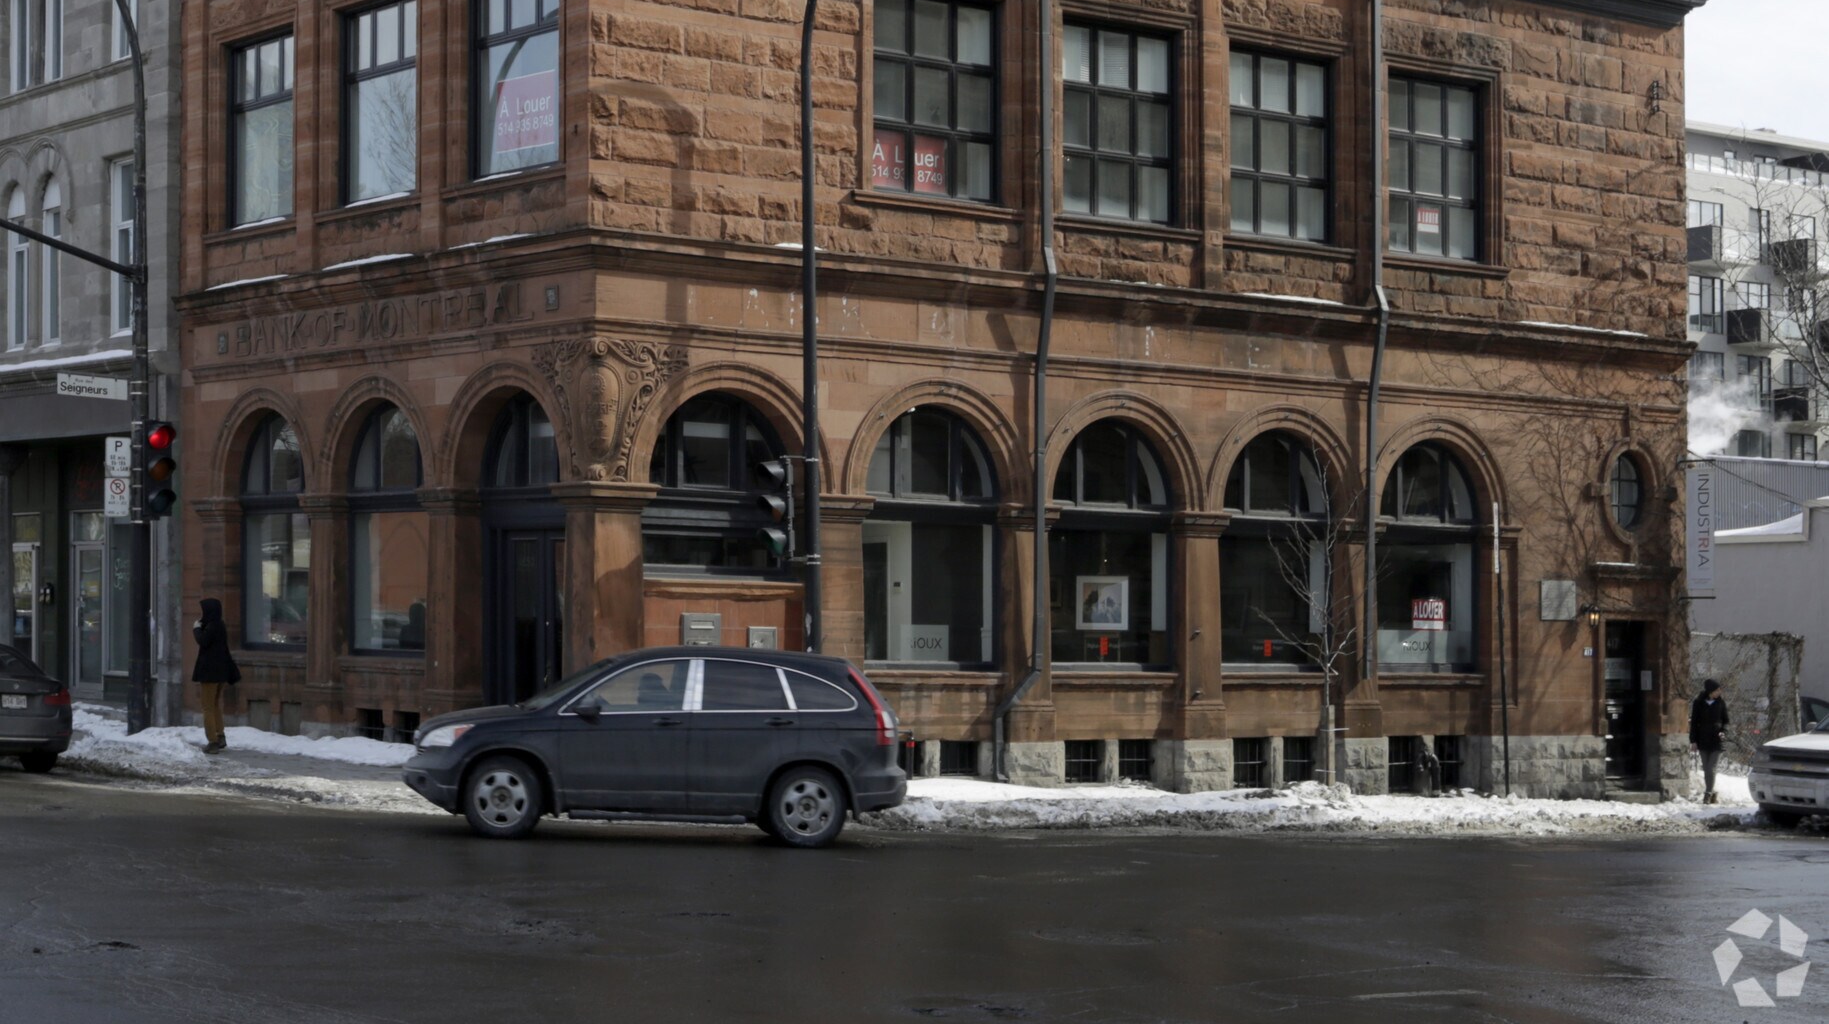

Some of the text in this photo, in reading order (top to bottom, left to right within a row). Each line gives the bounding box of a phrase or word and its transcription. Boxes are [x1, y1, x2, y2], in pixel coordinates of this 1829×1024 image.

[499, 95, 551, 118] À Louer
[497, 121, 513, 136] 514
[532, 113, 554, 130] 8749
[872, 139, 940, 168] À Luer
[917, 170, 943, 184] 8749
[236, 282, 535, 357] BANK OF MONTREAL
[60, 381, 108, 396] Seigneurs
[114, 440, 123, 452] P
[1697, 473, 1710, 568] INDUSTRIA
[1418, 601, 1444, 619] LOUER
